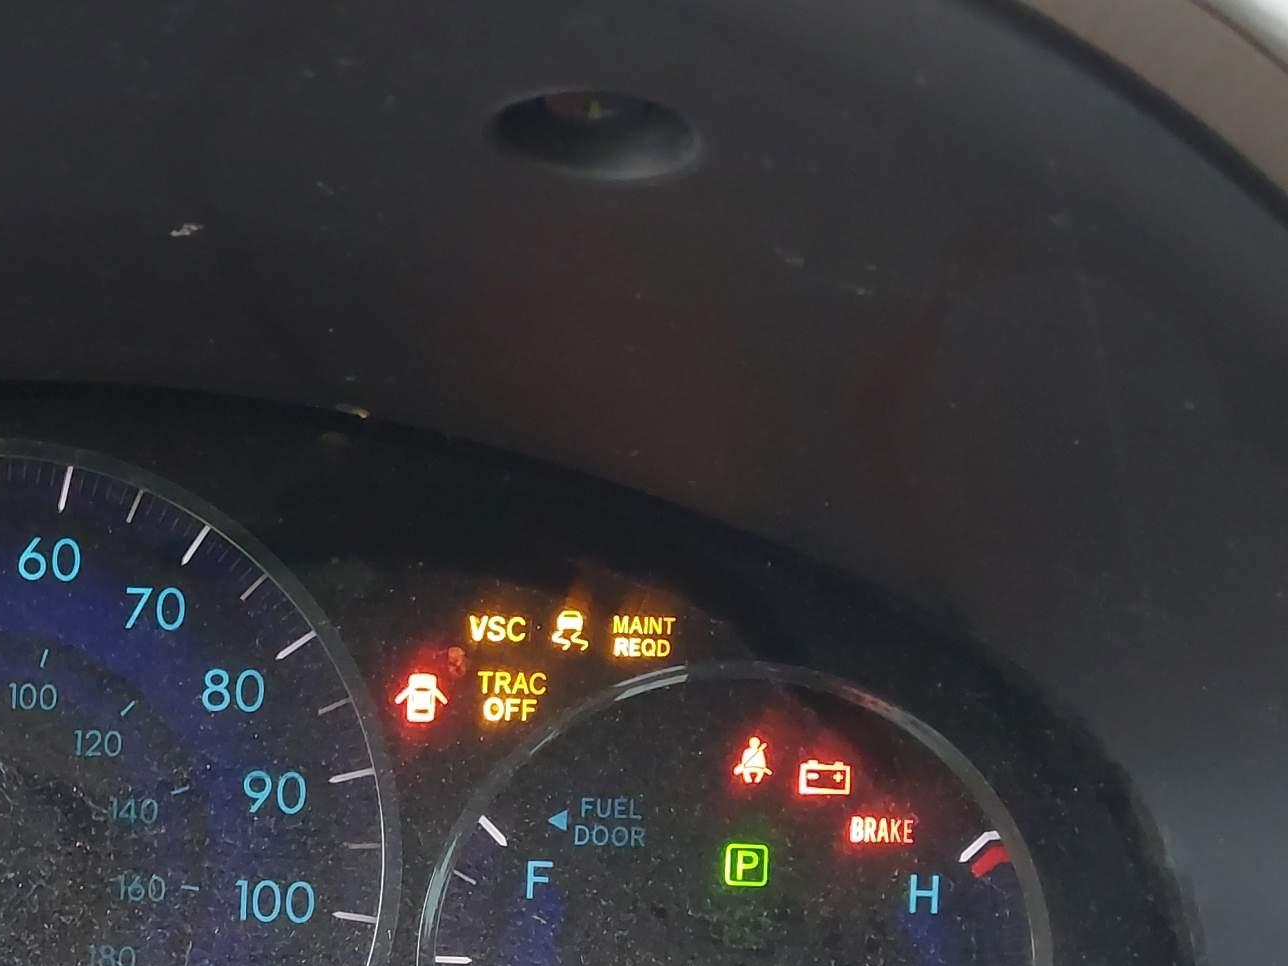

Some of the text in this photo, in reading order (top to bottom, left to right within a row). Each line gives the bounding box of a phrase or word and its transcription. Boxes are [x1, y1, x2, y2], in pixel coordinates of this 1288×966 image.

[18, 537, 81, 582] 60
[125, 586, 185, 631] 70
[468, 614, 527, 643] VSC
[612, 614, 677, 636] MAINT
[613, 636, 671, 658] REQD
[8, 682, 58, 711] 100
[201, 667, 265, 713] 80
[477, 670, 548, 695] TRAC
[482, 696, 538, 722] OFF
[74, 729, 122, 757] 120
[243, 770, 306, 815] 90
[109, 796, 159, 824] 140
[580, 796, 640, 819] FUEL
[573, 824, 644, 847] DOOR
[849, 815, 914, 844] BRAKE
[119, 873, 165, 902] 160
[526, 860, 553, 899] F
[908, 874, 940, 914] H
[236, 879, 315, 924] 100
